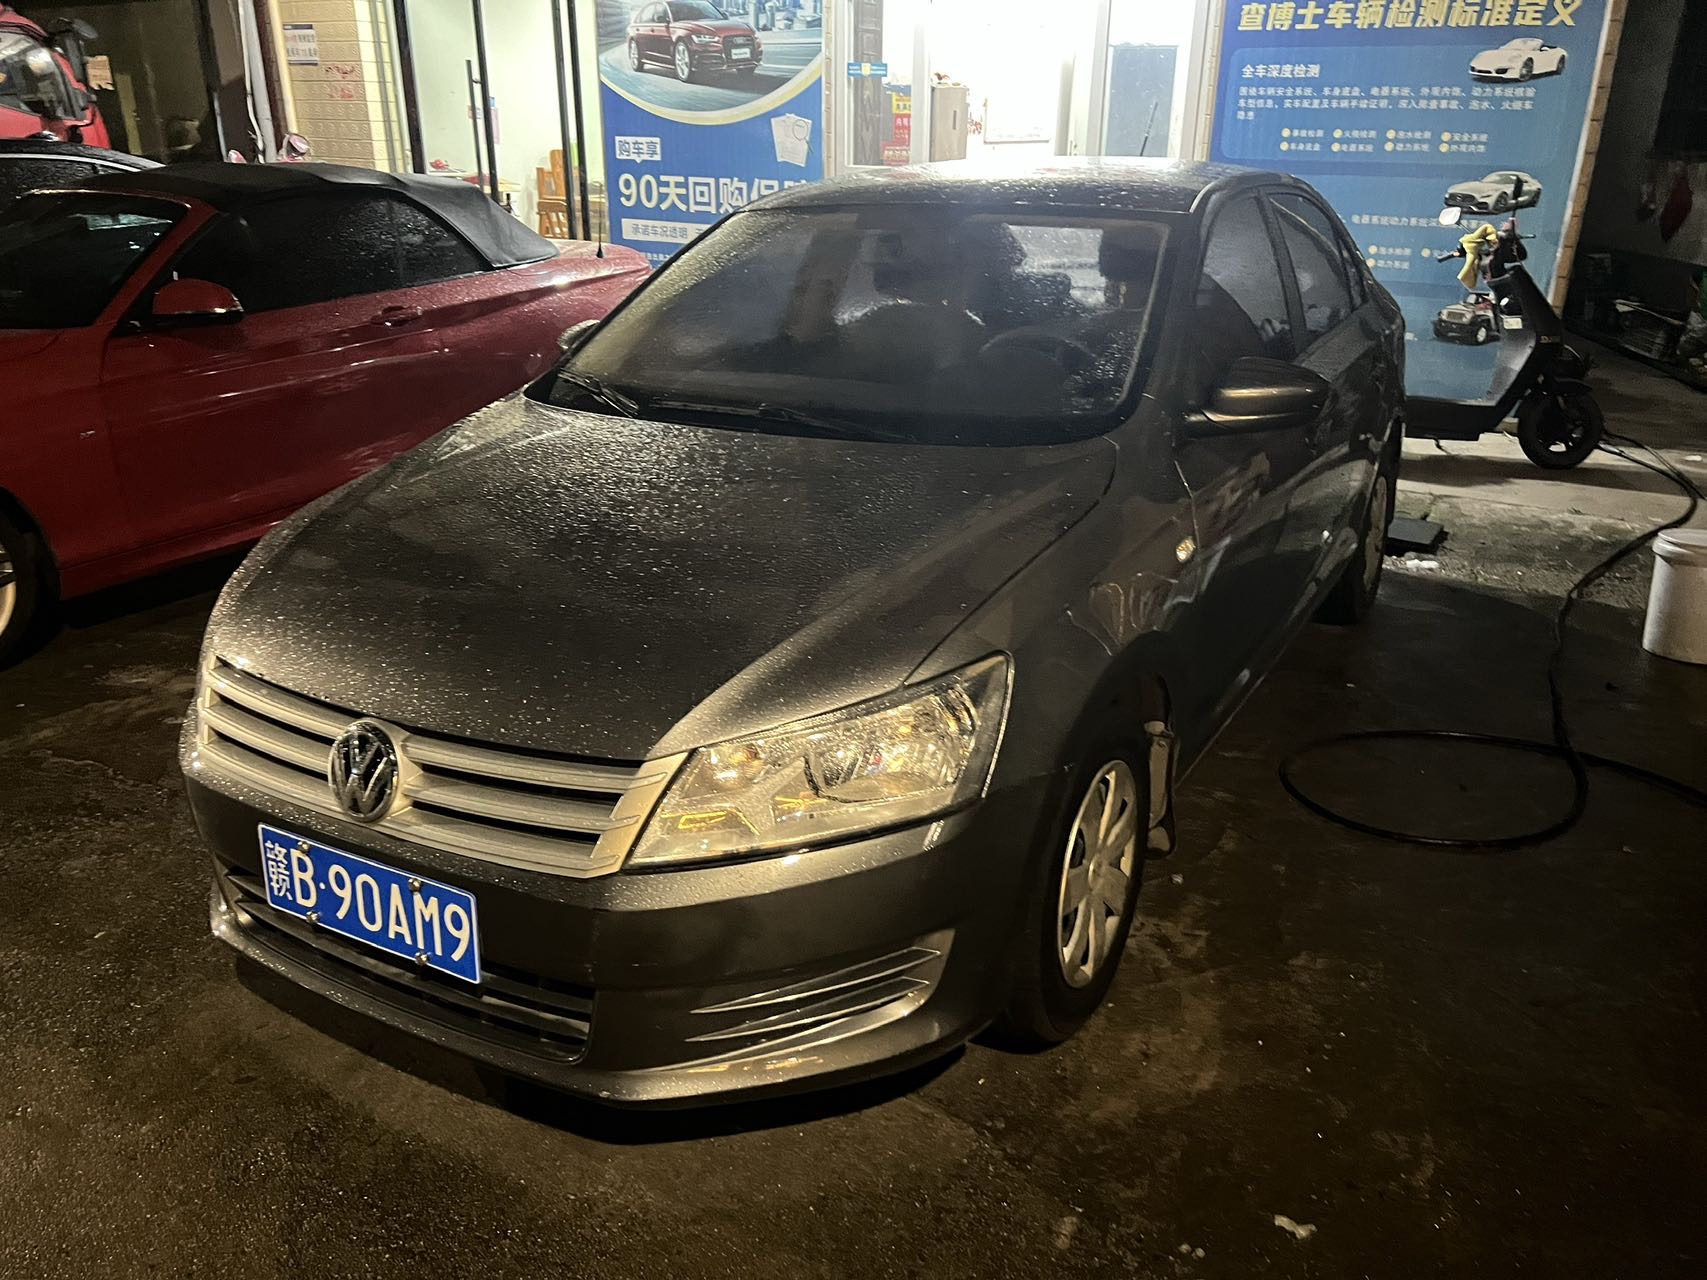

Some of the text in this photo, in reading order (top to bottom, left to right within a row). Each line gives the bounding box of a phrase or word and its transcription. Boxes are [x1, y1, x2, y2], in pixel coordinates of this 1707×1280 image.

[1237, 0, 1583, 31] 查博士车辆检测标准定义
[1241, 64, 1320, 78] 全车深度检测
[618, 140, 659, 157] 购车享
[618, 172, 808, 214] 90天回购保
[631, 223, 688, 239] 承诺车况透明
